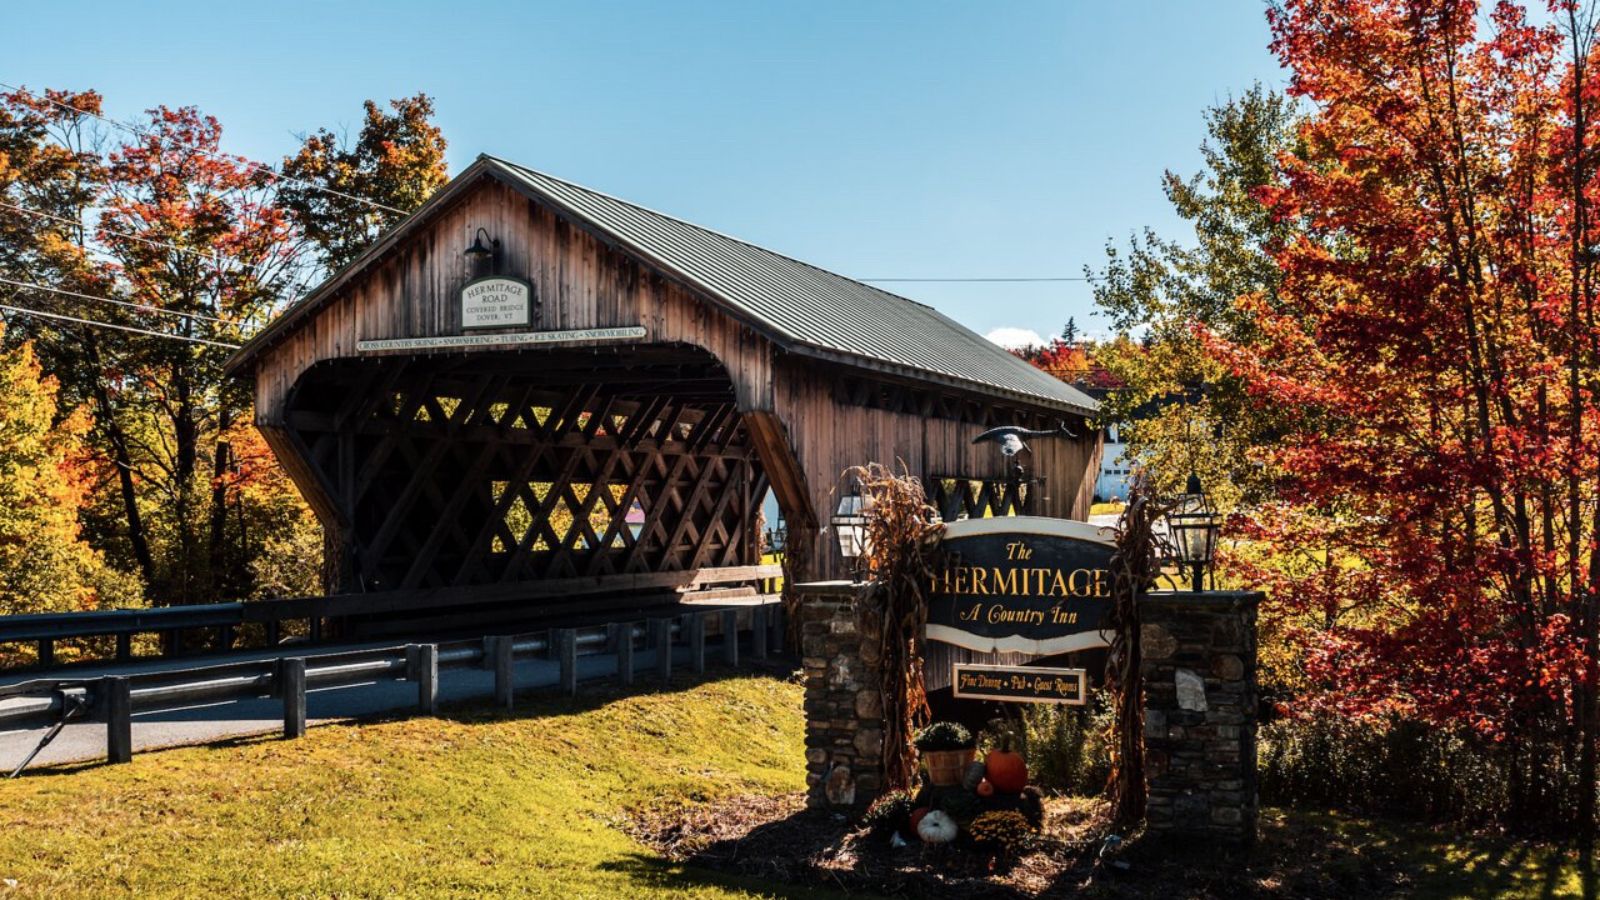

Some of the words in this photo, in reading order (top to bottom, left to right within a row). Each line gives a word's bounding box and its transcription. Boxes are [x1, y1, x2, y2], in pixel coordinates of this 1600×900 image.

[467, 283, 523, 299] HERMITAGE
[482, 294, 508, 303] ROAD
[466, 305, 497, 314] COVERED
[499, 304, 524, 312] BRIDGE
[379, 340, 414, 349] COUNTRY
[501, 334, 528, 342] TUBING
[547, 332, 577, 340] SKATING
[584, 328, 642, 337] SNOWMOBILING
[1006, 541, 1033, 561] The
[929, 567, 1111, 598] HERMITAGE
[959, 603, 983, 621] A
[987, 604, 1045, 626] Country
[1051, 606, 1078, 624] Inn
[960, 673, 977, 689] Fine
[978, 674, 1002, 690] Dining
[1011, 675, 1026, 690] Pub
[1034, 676, 1053, 694] Guest
[1055, 678, 1078, 697] Rooms
